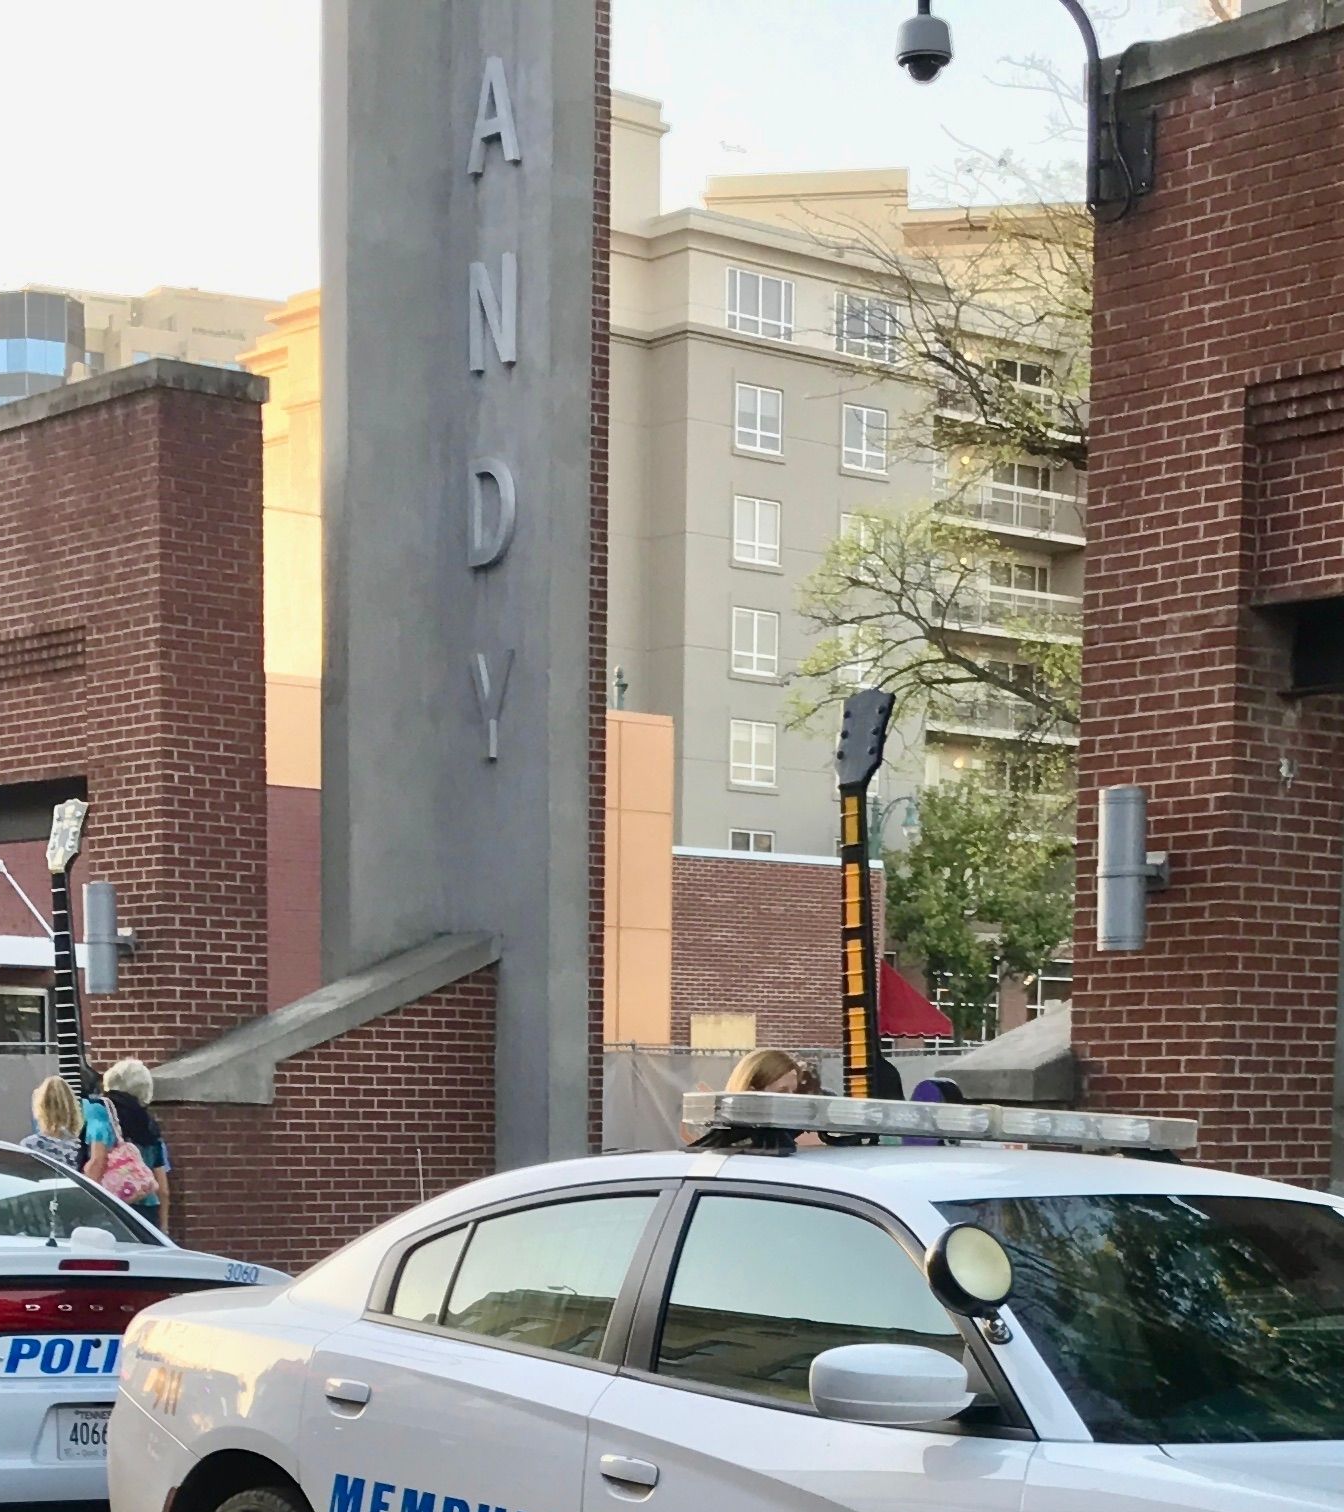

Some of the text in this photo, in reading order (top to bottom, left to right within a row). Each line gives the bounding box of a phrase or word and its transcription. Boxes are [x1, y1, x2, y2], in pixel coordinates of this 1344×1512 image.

[224, 1262, 260, 1284] 3060
[4, 1338, 120, 1374] POLI
[153, 1367, 184, 1416] 911
[80, 1410, 111, 1420] TENNE
